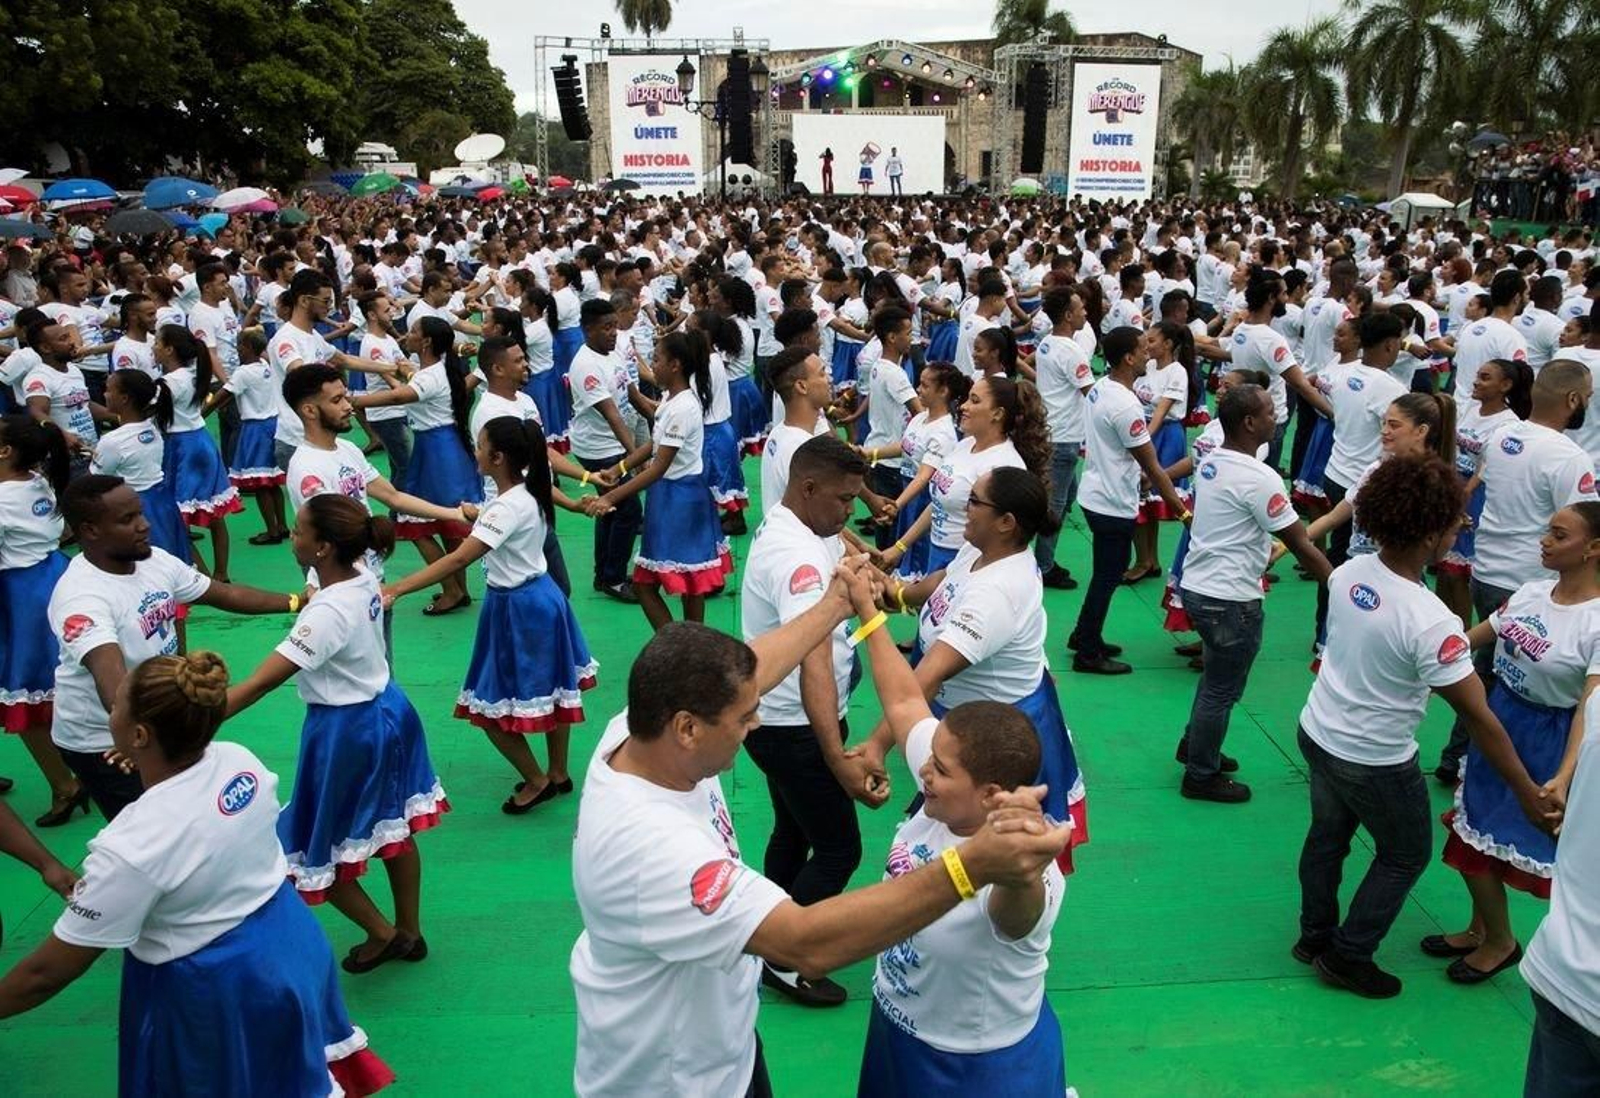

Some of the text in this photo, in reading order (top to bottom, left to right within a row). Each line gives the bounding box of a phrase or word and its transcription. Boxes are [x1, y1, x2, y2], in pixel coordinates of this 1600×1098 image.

[1087, 92, 1145, 114] MERENGUE
[634, 123, 677, 139] ÚNETE
[1092, 131, 1133, 146] ÚNETE
[623, 153, 690, 167] HISTORIA
[1079, 160, 1142, 172] HISTORIA
[1352, 587, 1377, 607] OPAL
[223, 776, 256, 811] OPAL
